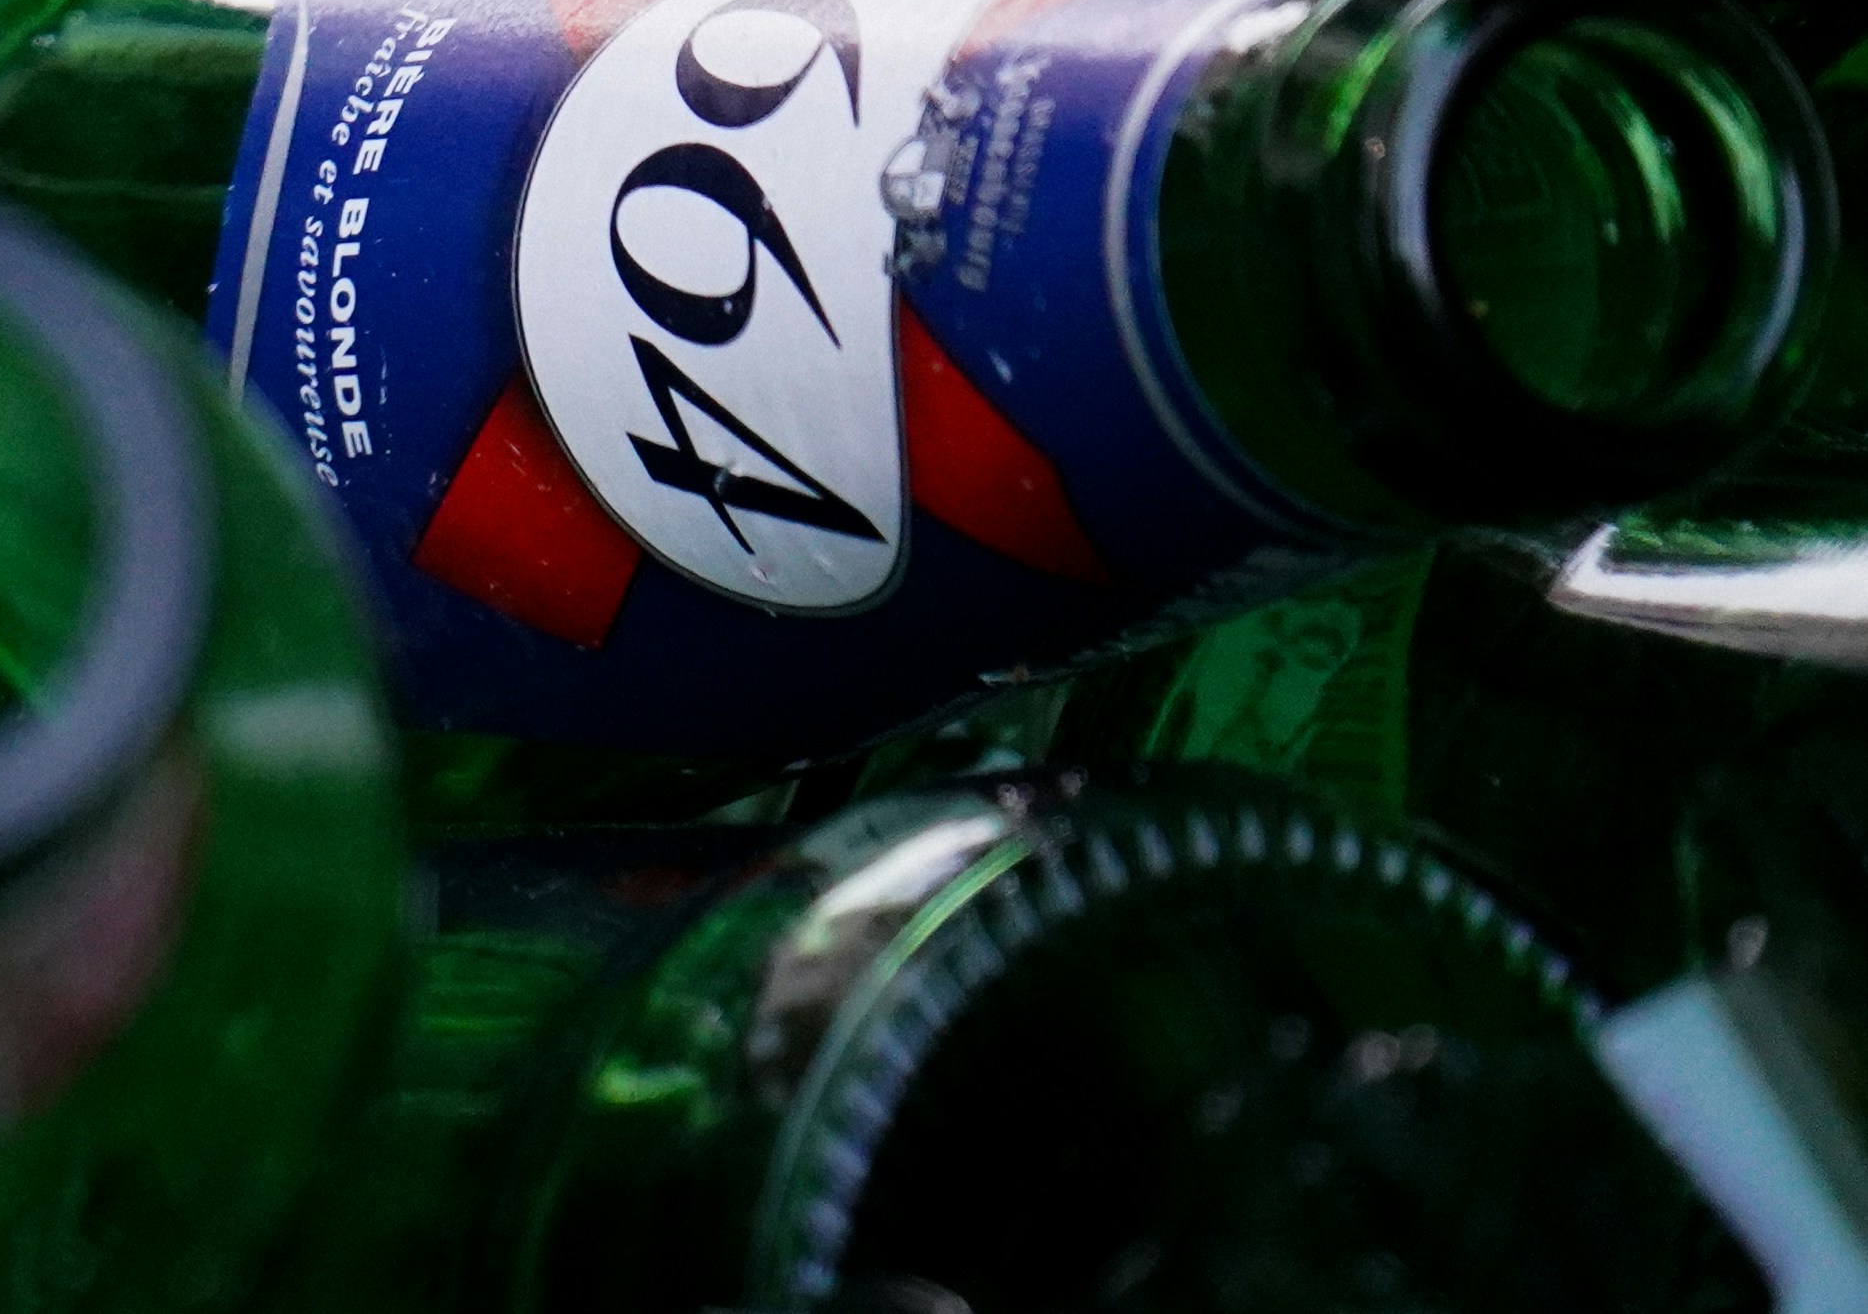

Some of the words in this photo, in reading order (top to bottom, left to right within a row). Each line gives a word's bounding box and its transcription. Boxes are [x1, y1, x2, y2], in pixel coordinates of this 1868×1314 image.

[331, 8, 428, 146] fraîche
[352, 17, 459, 175] BIÈRE
[313, 158, 338, 206] et
[295, 215, 340, 488] savoureuse
[329, 197, 373, 460] BLONDE
